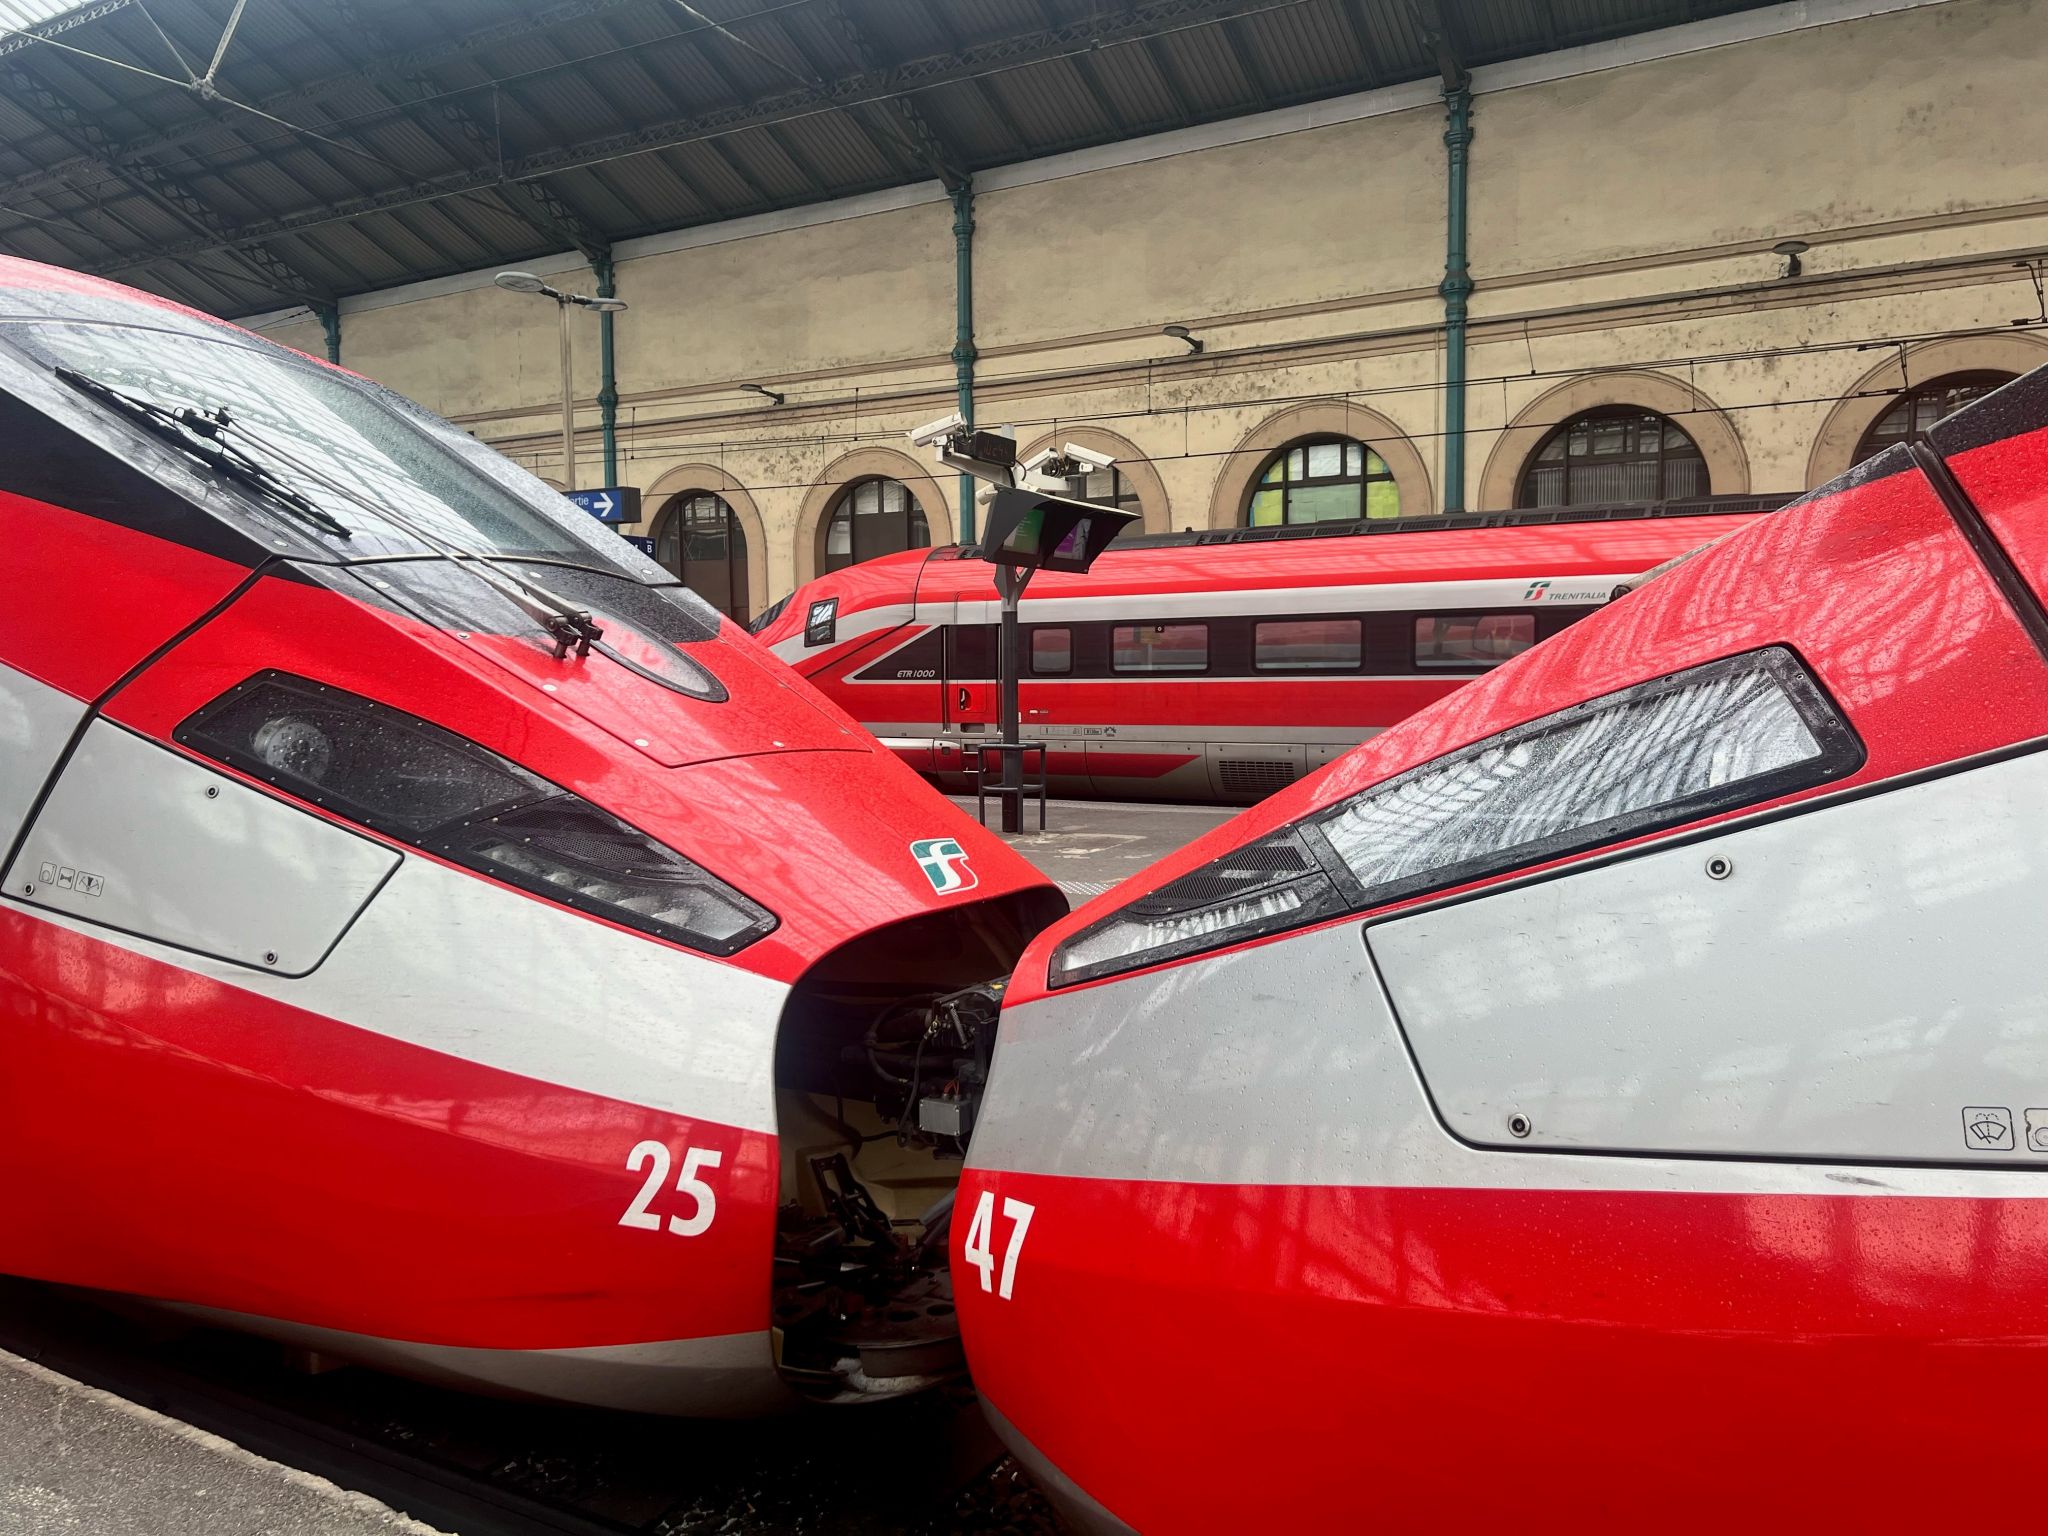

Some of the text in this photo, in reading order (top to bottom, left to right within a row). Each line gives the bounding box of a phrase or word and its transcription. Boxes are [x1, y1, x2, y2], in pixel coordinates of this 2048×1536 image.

[566, 495, 589, 506] ortie
[1549, 592, 1607, 601] TRENITALIA
[897, 669, 935, 678] ETR 1000
[618, 1140, 722, 1237] 25
[964, 1190, 1036, 1301] 47
